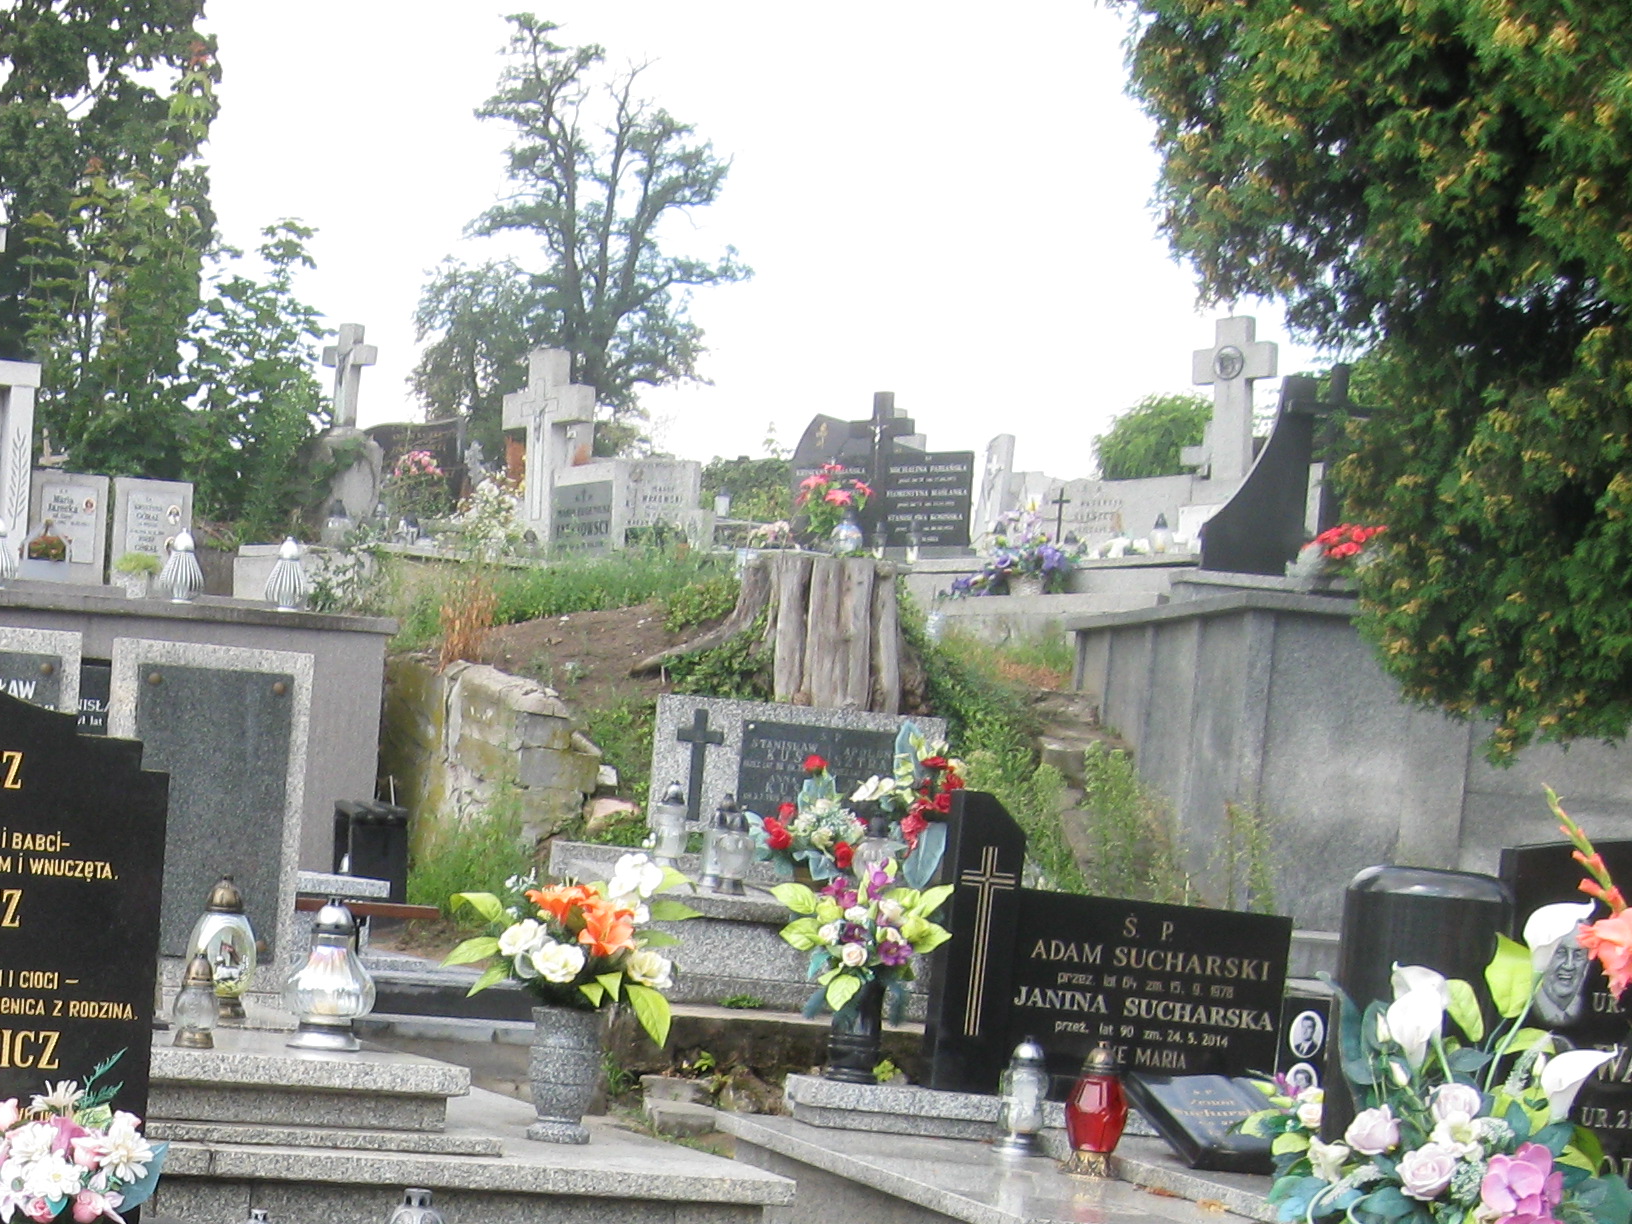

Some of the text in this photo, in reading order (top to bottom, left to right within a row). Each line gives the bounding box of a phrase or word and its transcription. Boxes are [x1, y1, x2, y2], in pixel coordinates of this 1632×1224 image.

[1030, 938, 1272, 982] ADAM SUCHARSKI
[19, 970, 59, 990] CIOCI
[1014, 985, 1274, 1033] JANINA SUCHARSKA
[1098, 1021, 1113, 1037] lat
[1120, 1024, 1134, 1039] 90
[1143, 1029, 1164, 1042] zm.
[1202, 1033, 1229, 1049] 2014
[1135, 1047, 1187, 1070] MARIA
